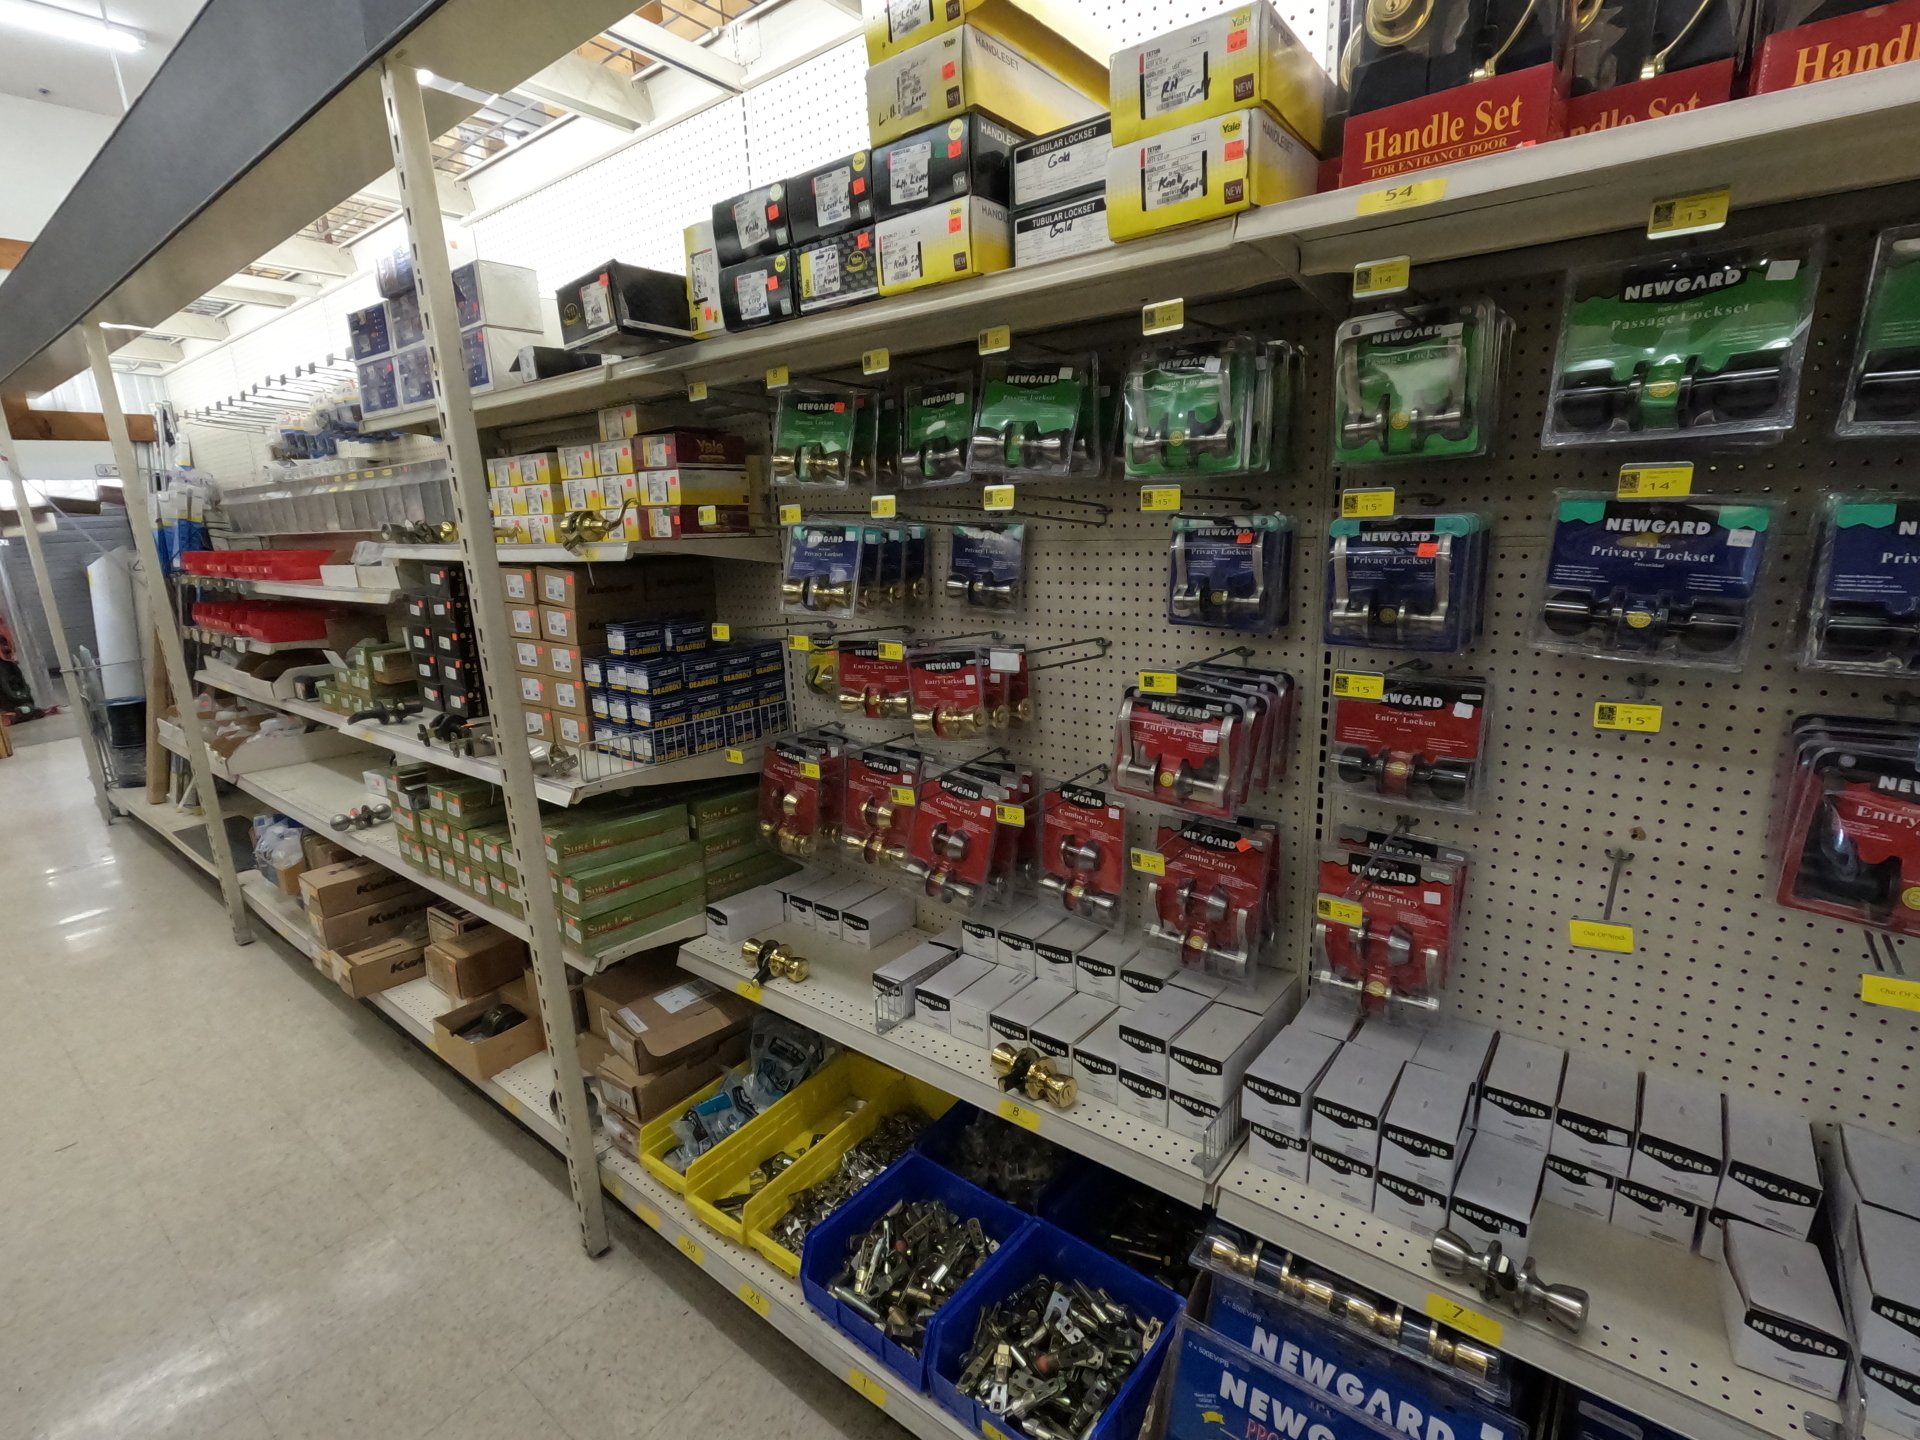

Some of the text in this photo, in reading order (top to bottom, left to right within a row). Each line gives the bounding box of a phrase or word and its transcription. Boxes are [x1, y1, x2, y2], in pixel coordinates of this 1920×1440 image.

[1232, 14, 1251, 29] Yale
[974, 35, 1020, 71] HANDLESET
[1235, 80, 1252, 95] NEW
[1222, 122, 1241, 135] Yale
[1363, 95, 1525, 165] Handle Set
[1032, 126, 1097, 157] TUBULAR LOCKSET
[1371, 136, 1509, 179] FOR ENTRANCE DOOR
[1226, 187, 1243, 199] NEW
[1385, 184, 1414, 204] 54
[1032, 202, 1096, 228] TUBULAR LOCKSET
[1624, 270, 1743, 301] NEWGARD
[1611, 303, 1751, 332] Passage Lockset
[1372, 323, 1443, 346] NEWGARD
[1006, 374, 1058, 384] NEWGARD
[797, 401, 835, 412] NEWGARD
[922, 392, 956, 407] NEWGARD
[698, 438, 724, 455] Yale
[1197, 528, 1250, 537] NEWGARD
[1606, 517, 1712, 536] NEWGARD
[1361, 532, 1431, 542] NEWGARD
[1191, 547, 1253, 557] Privacy Lockset
[1353, 555, 1433, 569] Privacy Lockset
[1591, 545, 1716, 564] Privacy Lockset
[676, 640, 707, 653] DEADBOLT
[756, 663, 784, 676] DEADBOLT
[925, 661, 961, 671] NEWGARD
[689, 676, 719, 690] DEADBOLT
[723, 670, 753, 683] DEADBOLT
[652, 681, 682, 697] DEADBOLT
[1151, 701, 1211, 720] NEWGARD
[1382, 693, 1443, 709] EWGARD
[654, 714, 686, 729] DEADBOLT
[692, 708, 722, 722] DEADBOLT
[1374, 713, 1399, 725] Entry
[1402, 716, 1437, 728] Lockset
[1627, 716, 1646, 725] 15
[1143, 721, 1171, 735] Entry
[935, 797, 958, 811] Combo
[958, 805, 978, 820] Entry
[1058, 808, 1083, 821] Combo
[1084, 816, 1105, 828] Entry
[1183, 852, 1209, 864] ombo
[1211, 857, 1238, 872] Entry
[1351, 863, 1417, 885] NWGARD
[1388, 896, 1420, 911] Entry
[999, 933, 1033, 952] NEWGARD
[1036, 948, 1071, 965] NEWGARD
[1077, 958, 1114, 977] NEWGARD
[1122, 973, 1162, 994] NEWGARD
[916, 991, 948, 1013] NEWGARD
[991, 1019, 1026, 1042] NEWGARD
[1031, 1036, 1067, 1058] NEWGARD
[1121, 1031, 1164, 1054] NEWGARD
[1074, 1051, 1115, 1076] NEWGARD
[1172, 1052, 1220, 1075] NEWGARD
[1121, 1076, 1165, 1100] NEWGARD
[1247, 1079, 1297, 1105] NEWGARD
[1172, 1095, 1220, 1120] NEWGARD
[1486, 1091, 1546, 1118] NEWGARD
[1316, 1103, 1373, 1130] NEWGARD
[1253, 1125, 1304, 1152] NEWGARD
[1386, 1130, 1449, 1158] NEWGARD
[1313, 1149, 1369, 1177] NEWGARD
[1643, 1144, 1714, 1175] NEWGARD
[1381, 1176, 1441, 1206] NEWGARD
[1734, 1170, 1811, 1205] NEWGARD
[1620, 1184, 1688, 1215] NEWGARD
[1456, 1203, 1521, 1236] NEWGARD
[1453, 1305, 1464, 1318] 7
[1752, 1318, 1839, 1356] NEWGARD
[1198, 1346, 1230, 1369] 500EV/PB
[1251, 1326, 1457, 1440] NEWGARD
